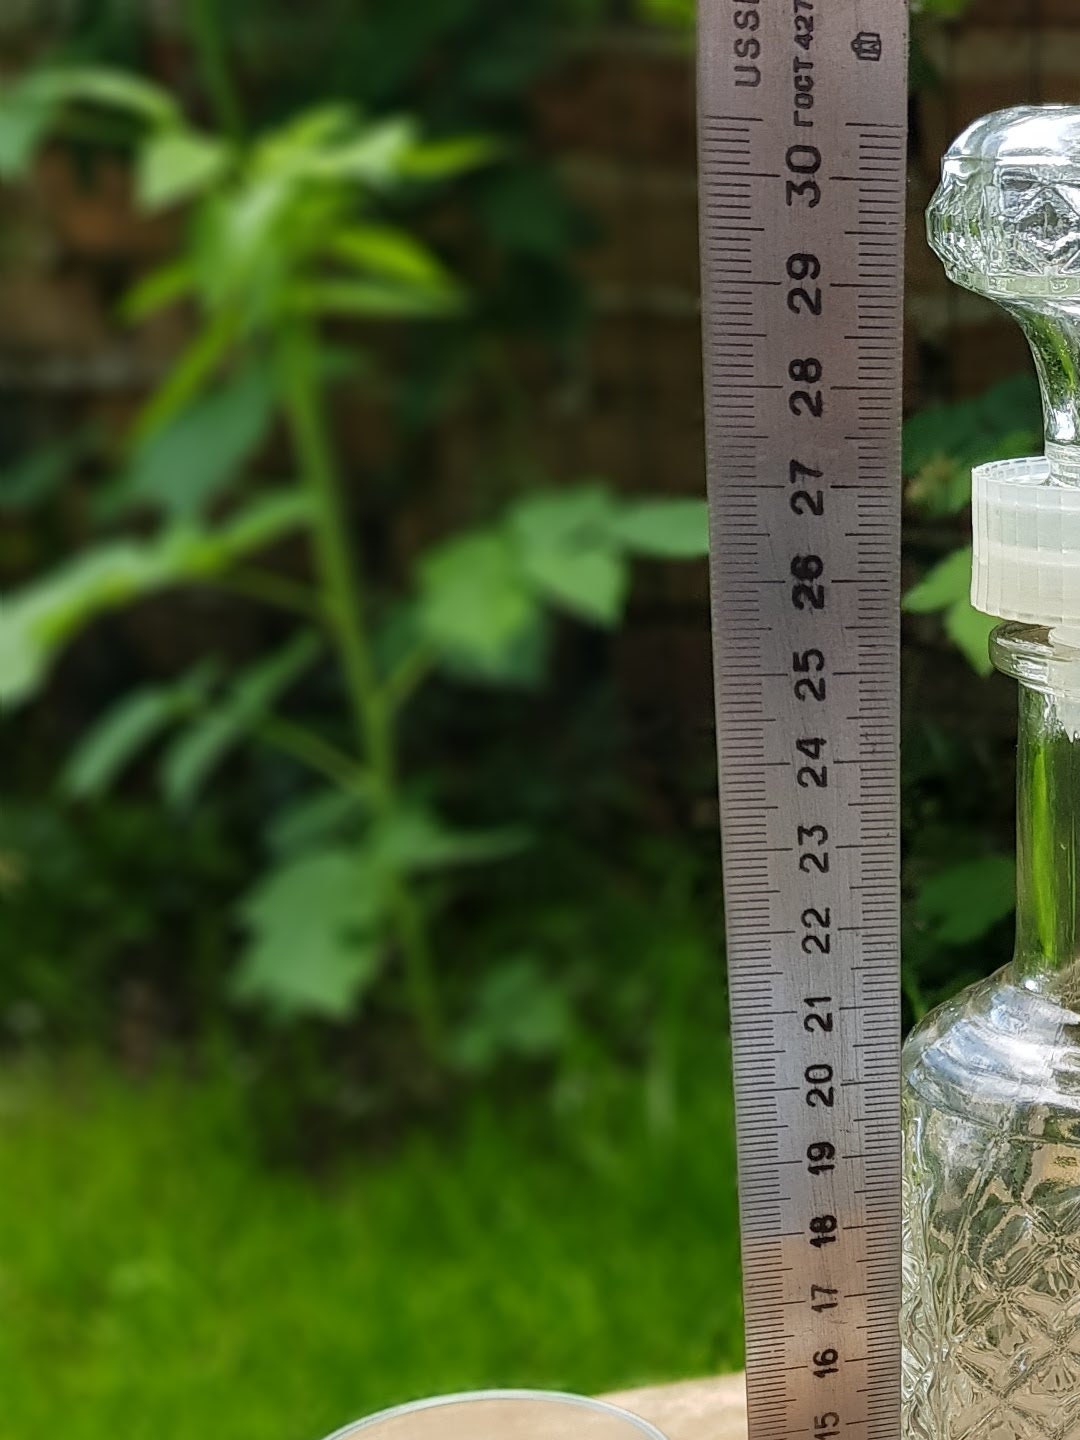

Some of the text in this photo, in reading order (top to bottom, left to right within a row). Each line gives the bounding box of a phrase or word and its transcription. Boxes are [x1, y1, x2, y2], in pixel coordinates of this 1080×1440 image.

[733, 0, 762, 88] USS
[793, 55, 815, 128] ГОСТ
[785, 144, 822, 209] 30
[785, 252, 823, 316] 29
[788, 357, 824, 418] 28
[789, 458, 825, 516] 27
[790, 554, 825, 611] 26
[792, 648, 826, 702] 25
[795, 737, 828, 789] 24
[796, 824, 830, 874] 23
[800, 907, 831, 955] 22
[803, 996, 834, 1033] 21
[803, 1063, 835, 1108] 20
[806, 1141, 836, 1176] 19
[809, 1214, 838, 1249] 18
[810, 1283, 839, 1314] 17
[812, 1348, 840, 1379] 16
[813, 1411, 841, 1440] 15
